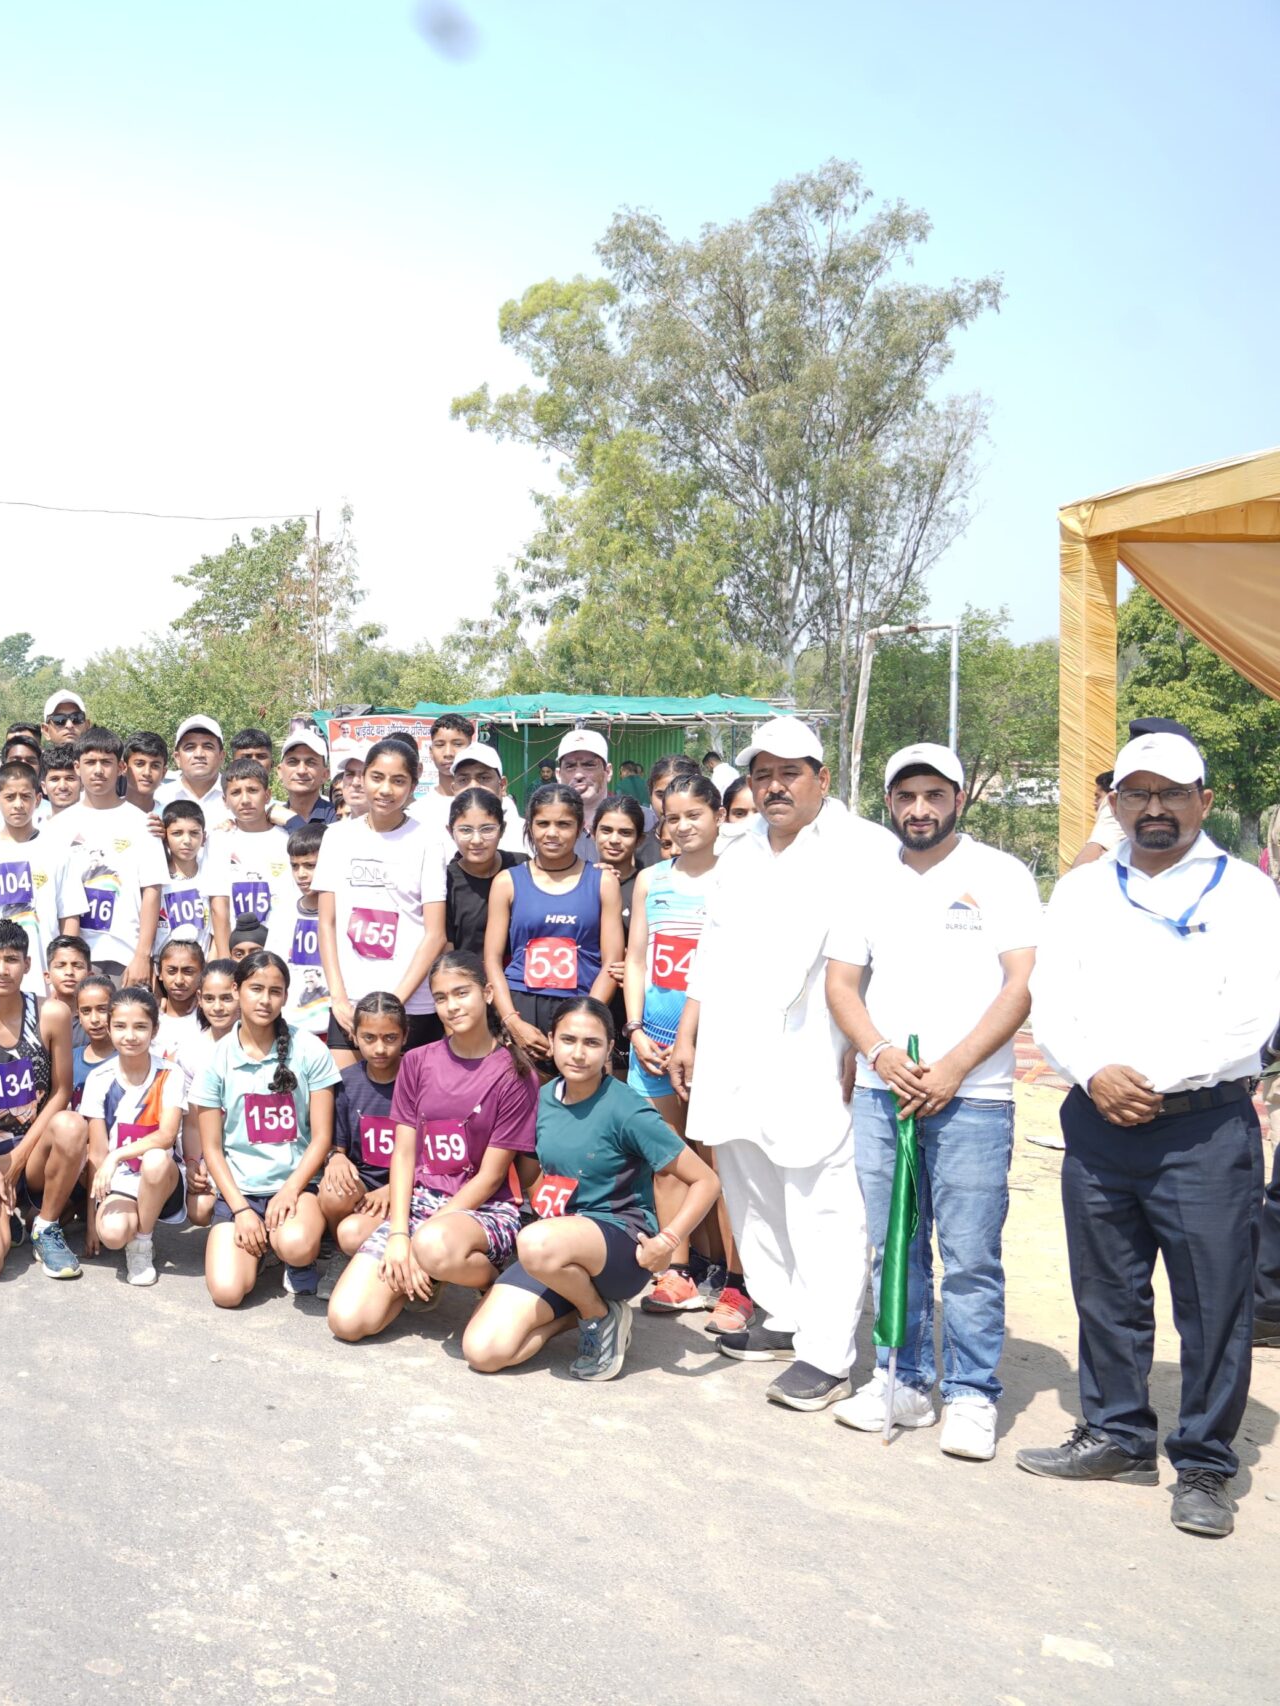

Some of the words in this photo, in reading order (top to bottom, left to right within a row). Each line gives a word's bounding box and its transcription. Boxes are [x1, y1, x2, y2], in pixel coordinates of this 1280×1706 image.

[171, 899, 204, 923] 105
[235, 892, 269, 913] 115
[545, 914, 577, 924] HRX
[296, 930, 318, 954] 10
[352, 920, 396, 948] 155
[529, 947, 575, 979] 53
[655, 944, 696, 977] 54
[249, 1105, 295, 1130] 158
[364, 1128, 394, 1154] 15
[424, 1133, 466, 1160] 159
[535, 1184, 572, 1218] 55
